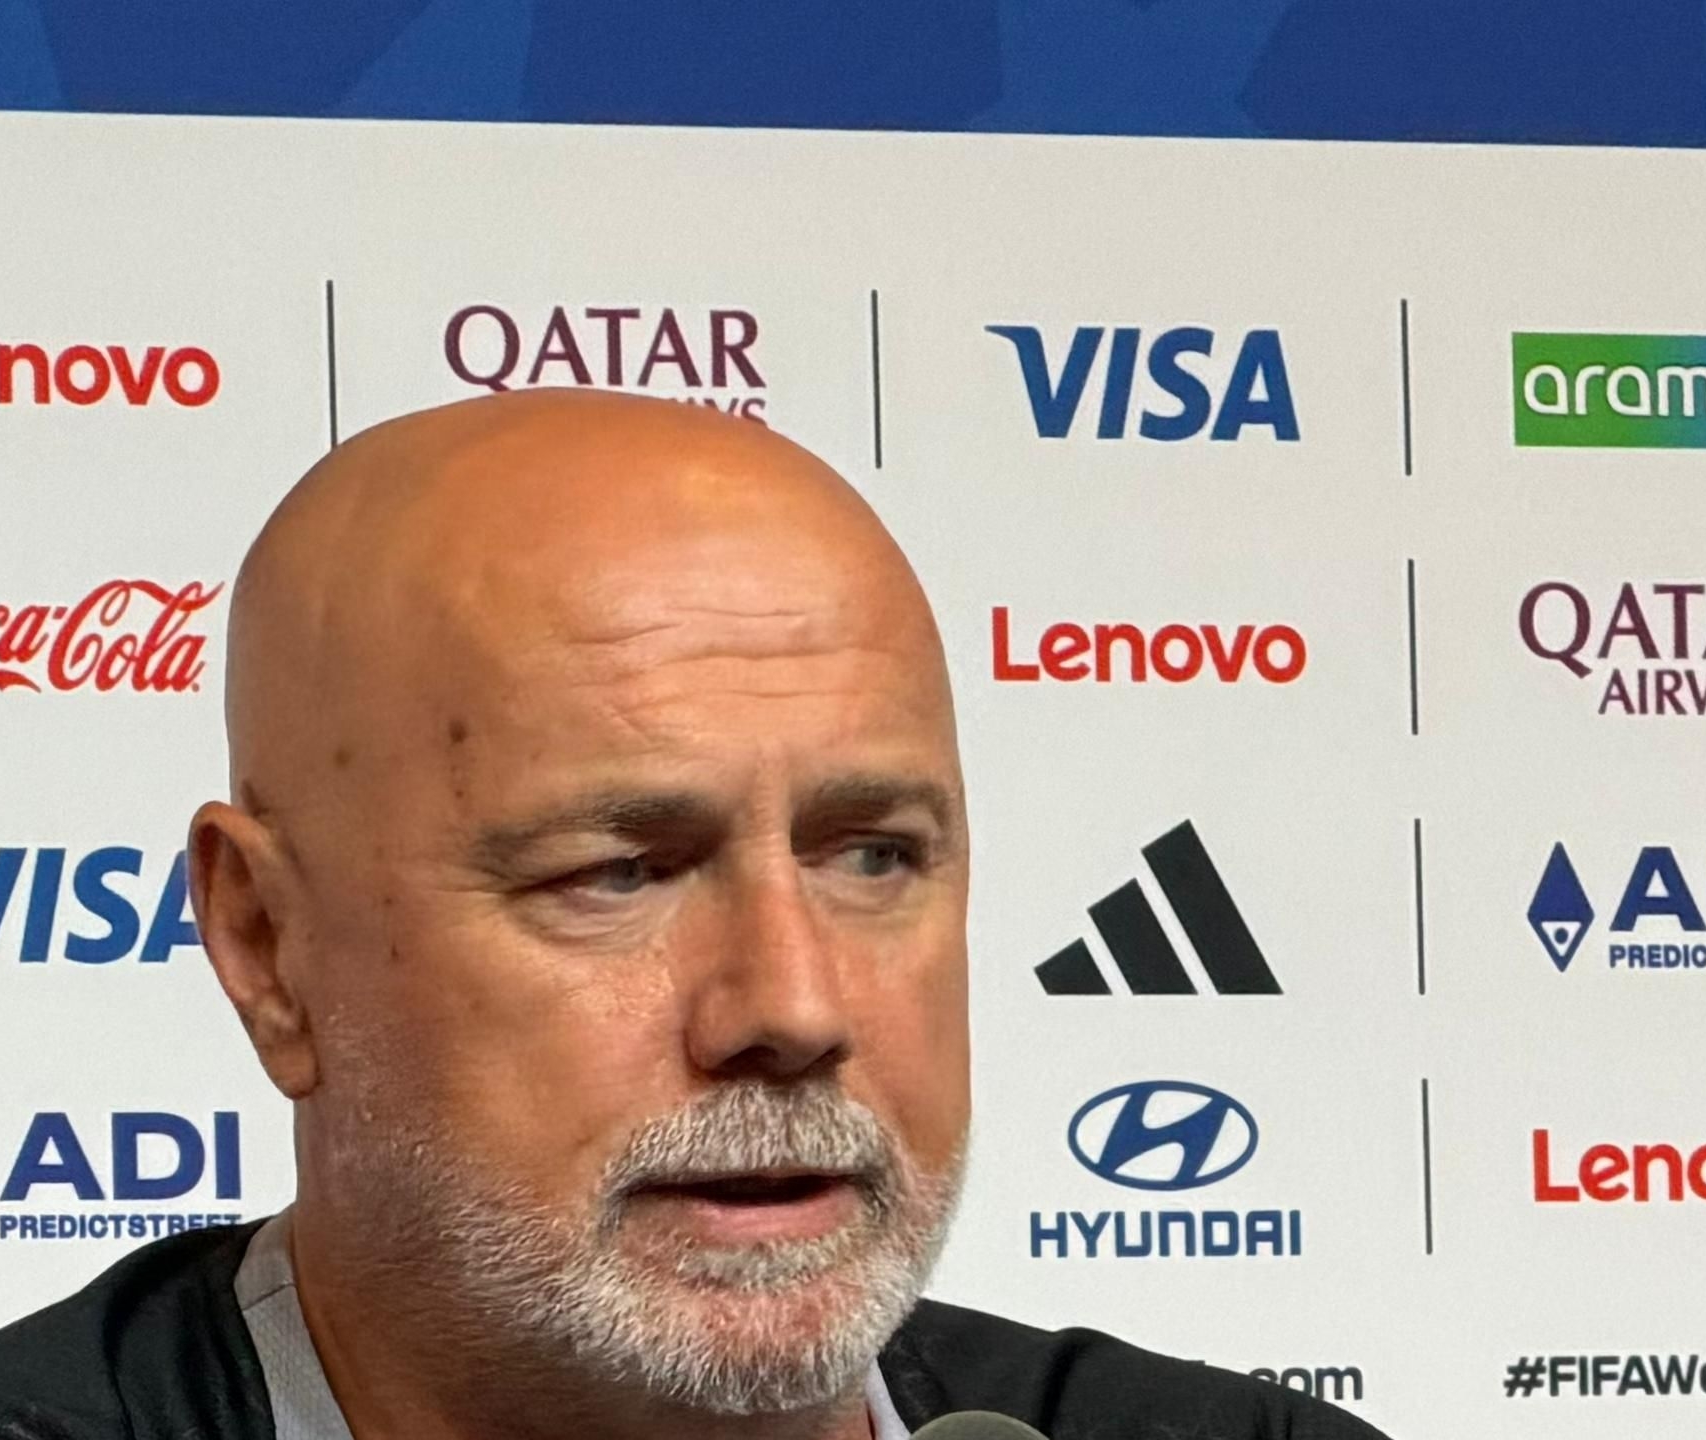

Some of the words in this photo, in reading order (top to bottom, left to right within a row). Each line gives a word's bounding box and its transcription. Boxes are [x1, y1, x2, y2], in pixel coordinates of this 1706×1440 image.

[444, 304, 767, 392] QATAR
[986, 326, 1300, 441] VISA
[993, 607, 1306, 683] Lenovo
[0, 1112, 241, 1201] ADI
[1031, 1210, 1301, 1257] HYUNDAI
